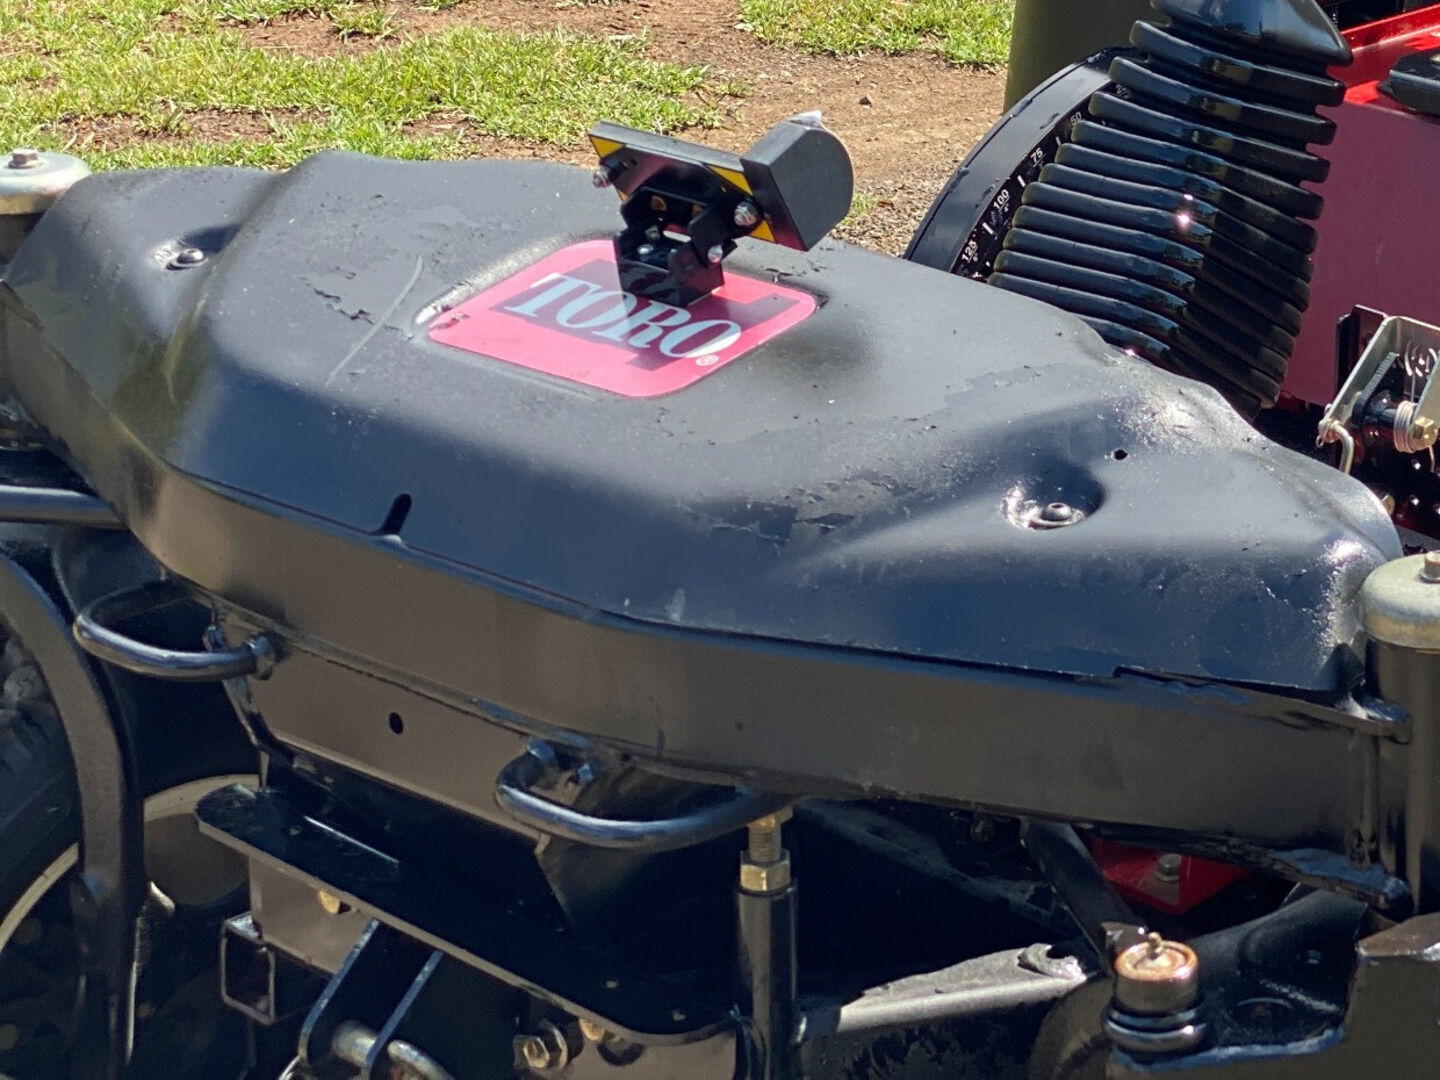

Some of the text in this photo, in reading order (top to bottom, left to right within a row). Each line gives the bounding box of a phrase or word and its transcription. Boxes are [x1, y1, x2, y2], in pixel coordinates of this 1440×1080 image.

[1030, 147, 1043, 163] 75
[993, 189, 1009, 210] 100
[504, 272, 741, 358] TORO
